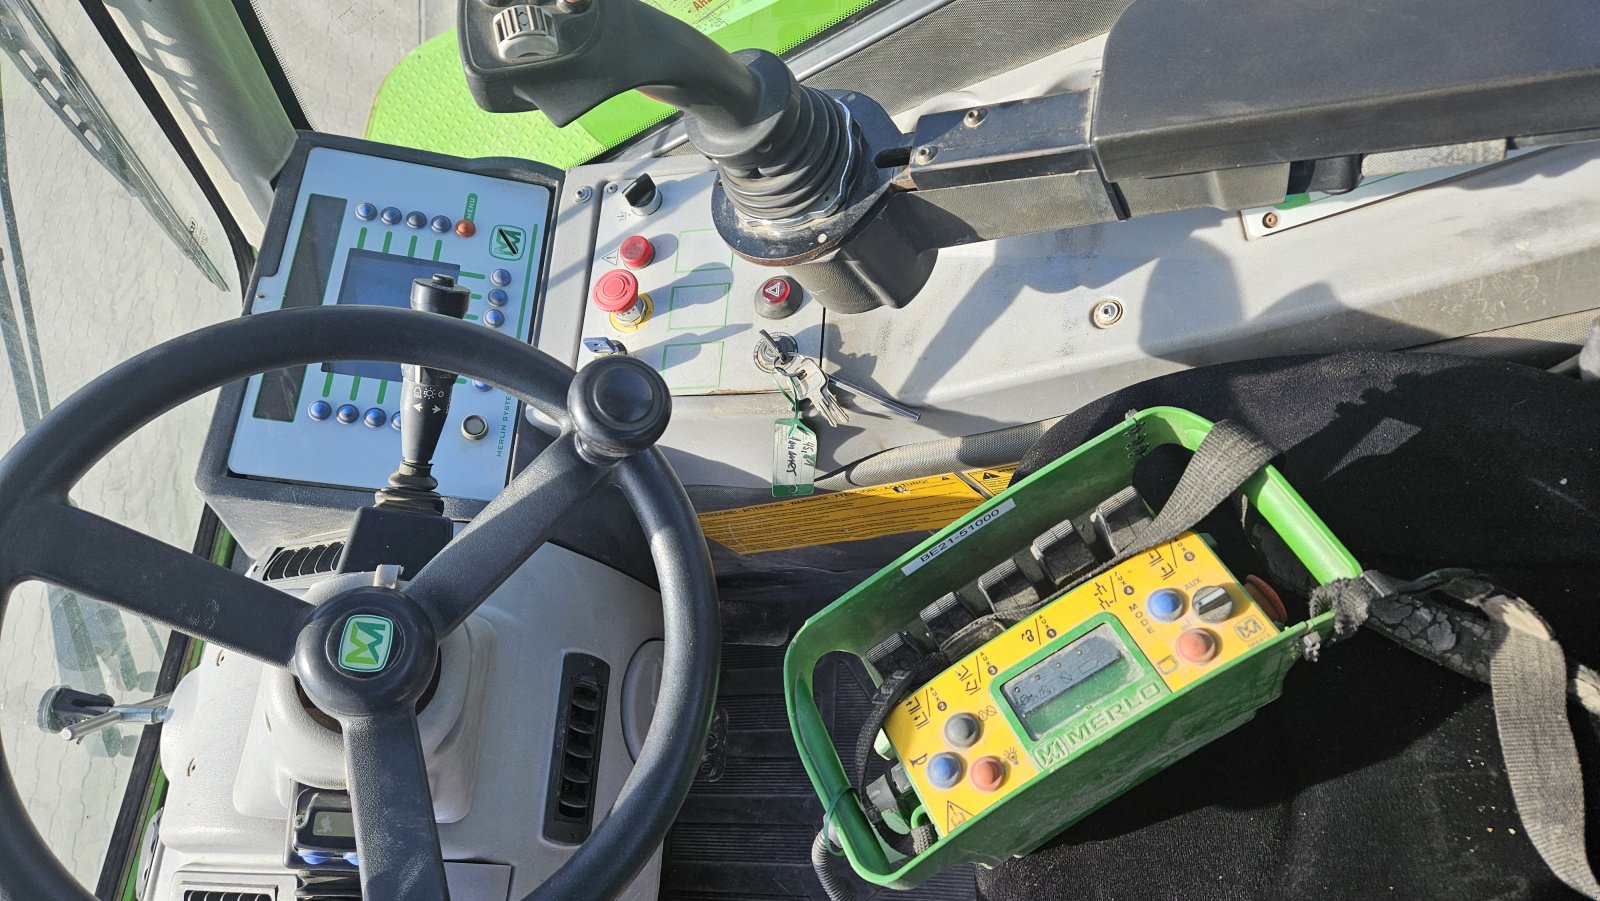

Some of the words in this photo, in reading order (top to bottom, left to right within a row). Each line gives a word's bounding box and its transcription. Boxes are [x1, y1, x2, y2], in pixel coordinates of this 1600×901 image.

[467, 197, 475, 219] MENU
[496, 424, 507, 457] MERLIN
[502, 394, 512, 422] SYSTE
[920, 509, 999, 563] BE21-51000
[1184, 577, 1203, 591] AUX
[1129, 603, 1155, 635] MODE
[980, 652, 991, 666] AUX
[929, 687, 941, 702] AUX
[1064, 682, 1161, 745] MERLO
